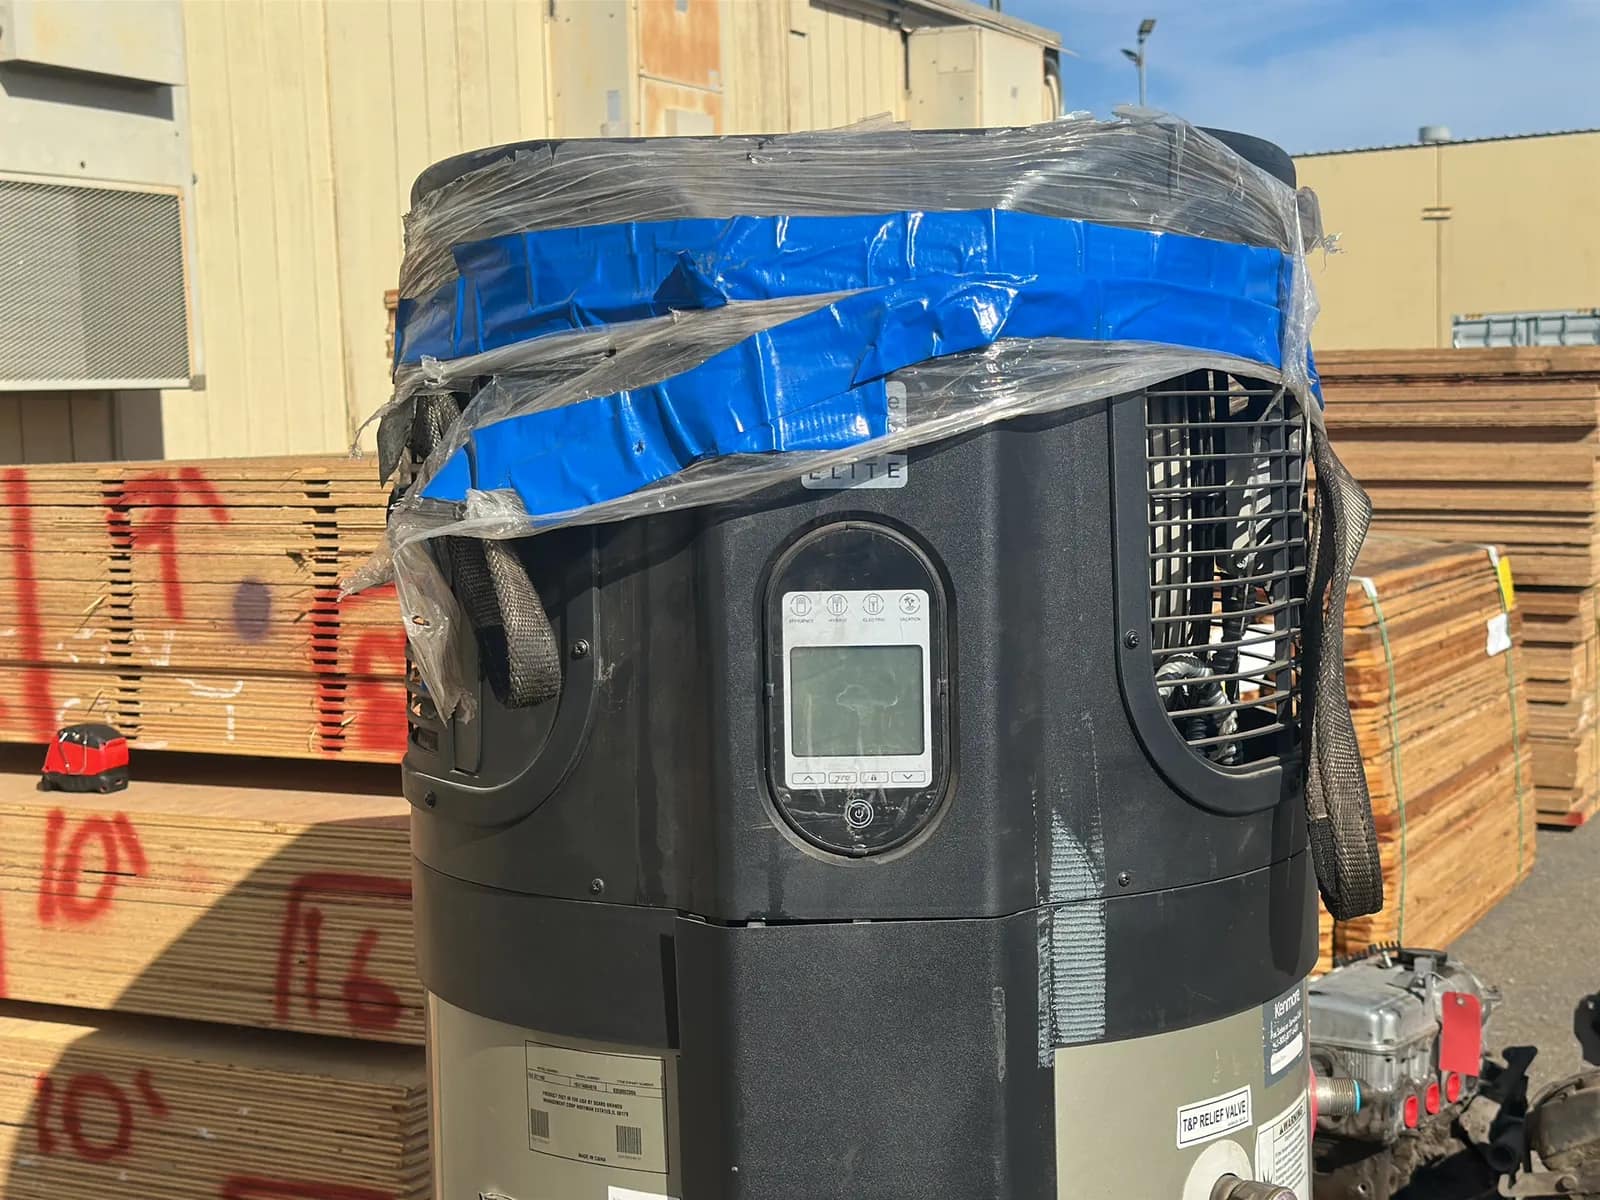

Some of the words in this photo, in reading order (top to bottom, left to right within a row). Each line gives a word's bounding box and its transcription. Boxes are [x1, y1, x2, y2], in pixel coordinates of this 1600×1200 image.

[808, 461, 901, 480] ELITE
[1274, 988, 1301, 1019] Kenmore
[1183, 1116, 1198, 1133] T&P
[1199, 1108, 1225, 1128] RELIEF
[1225, 1099, 1247, 1119] VALVE
